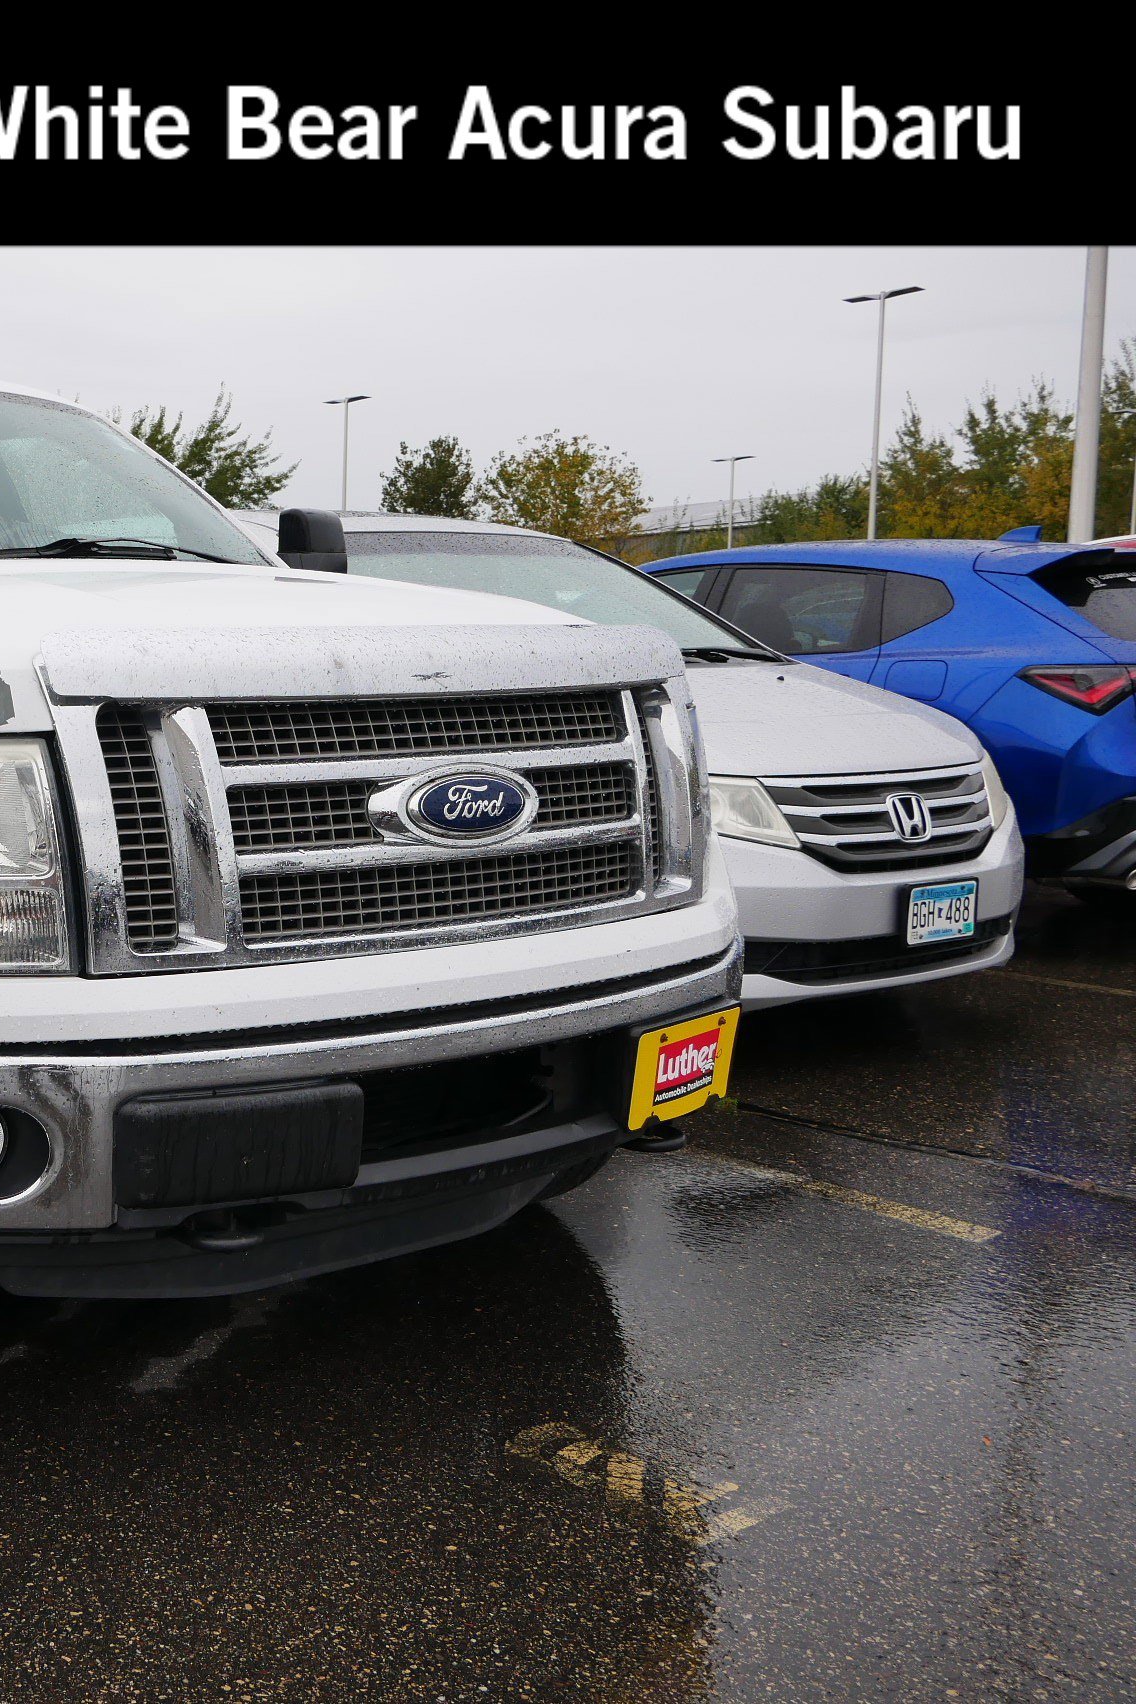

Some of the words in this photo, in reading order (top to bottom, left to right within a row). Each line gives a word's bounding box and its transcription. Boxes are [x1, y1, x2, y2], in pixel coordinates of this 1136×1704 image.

[443, 784, 505, 821] Ford
[911, 900, 936, 929] BGH
[945, 896, 971, 925] 488
[657, 1042, 718, 1084] Luther
[654, 1086, 687, 1102] Automobile
[687, 1075, 713, 1092] Dealerships
